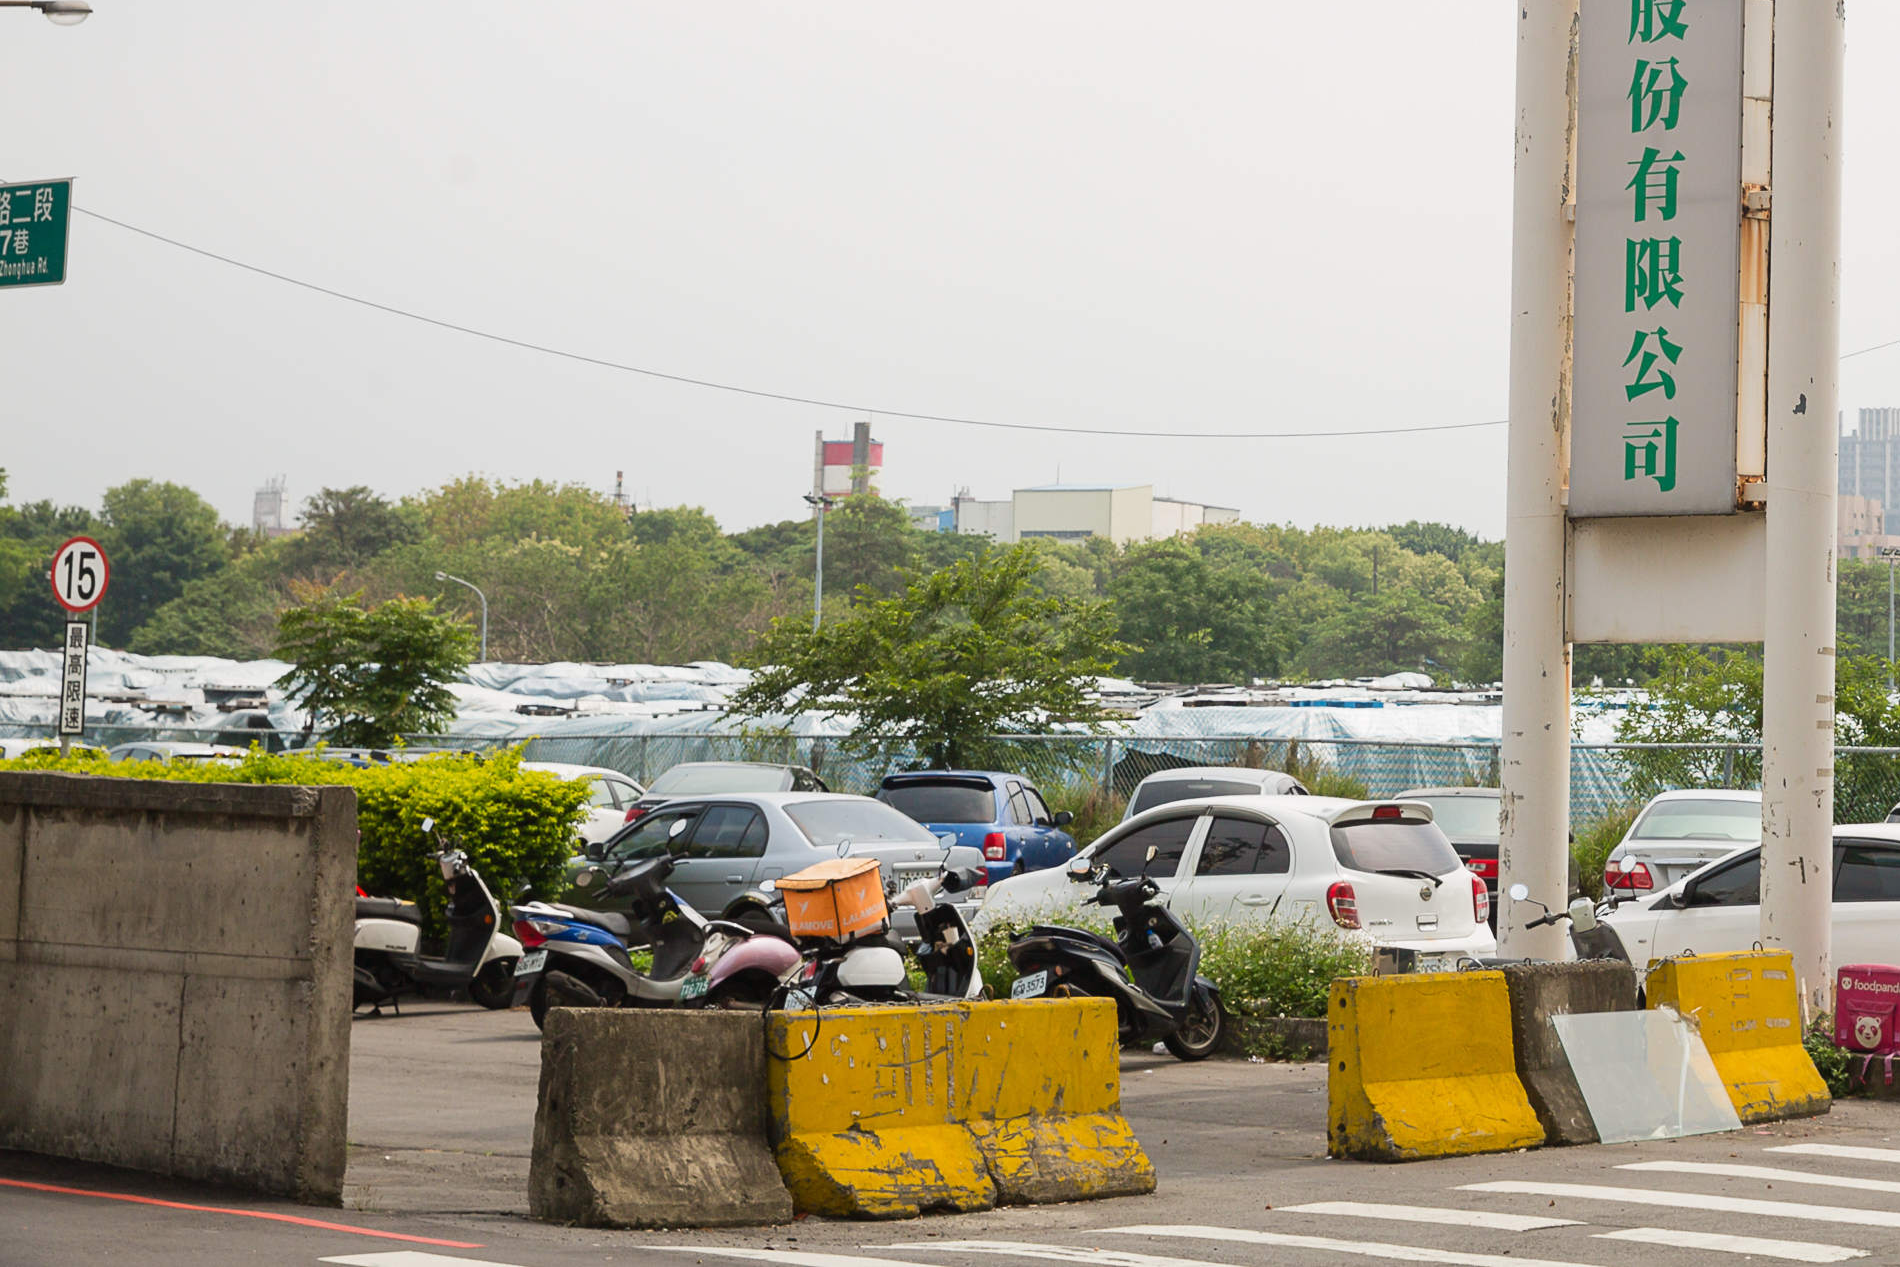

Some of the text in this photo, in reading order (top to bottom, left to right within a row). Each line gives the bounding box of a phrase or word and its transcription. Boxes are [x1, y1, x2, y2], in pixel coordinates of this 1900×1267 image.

[0, 256, 49, 280] Zhonghua Rd.
[64, 550, 96, 600] 15
[65, 626, 83, 729] 最高限速
